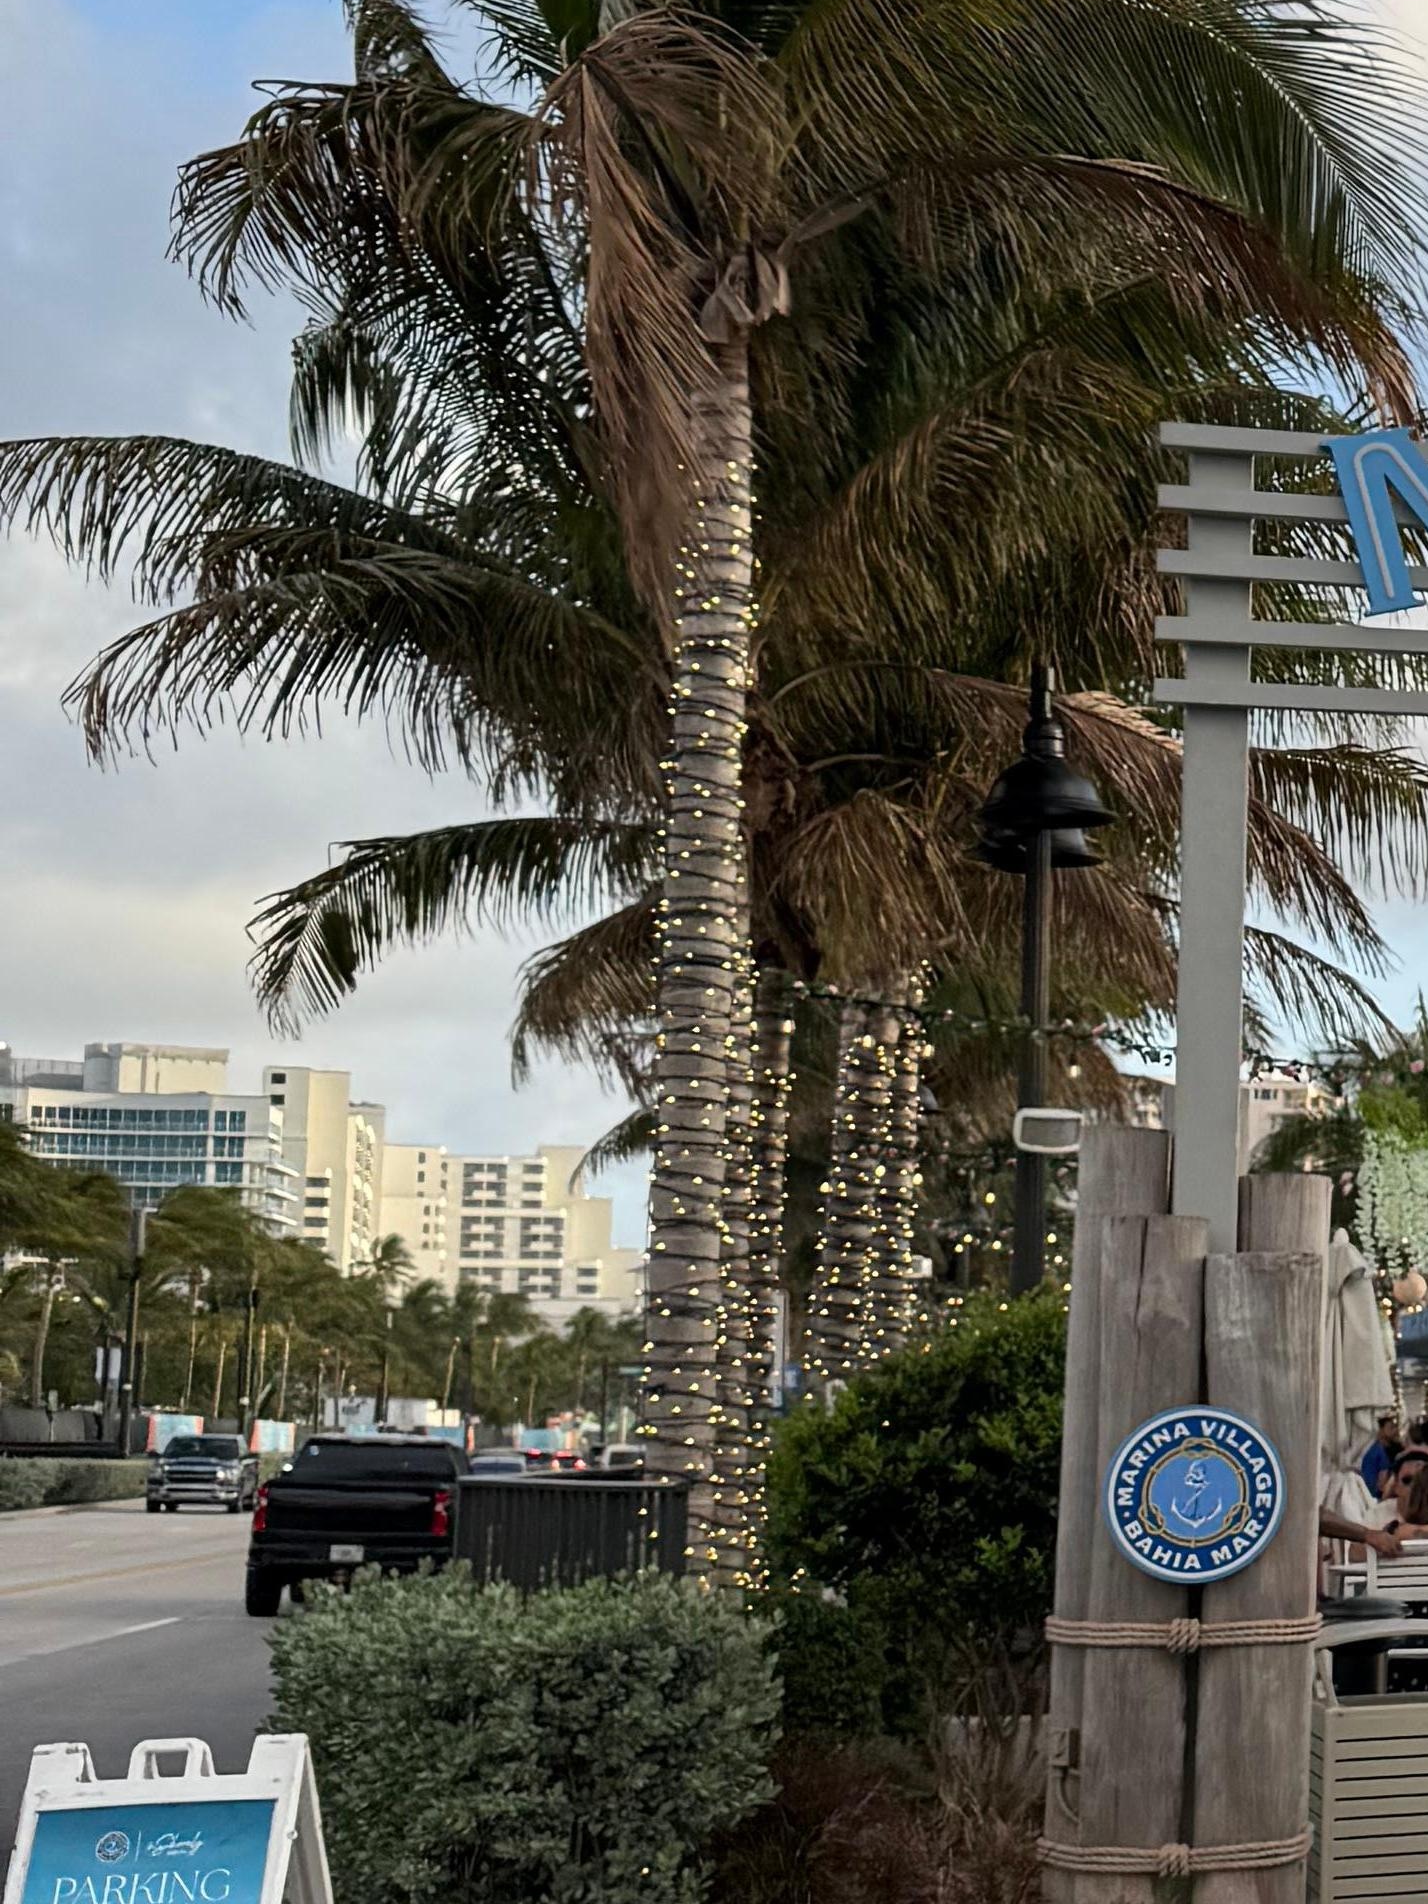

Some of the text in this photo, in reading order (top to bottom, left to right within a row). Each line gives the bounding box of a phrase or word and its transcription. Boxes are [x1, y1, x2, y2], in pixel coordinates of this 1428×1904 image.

[1117, 1420, 1273, 1510] MARINA VILLAGE
[1123, 1518, 1264, 1570] BAHIA MAR
